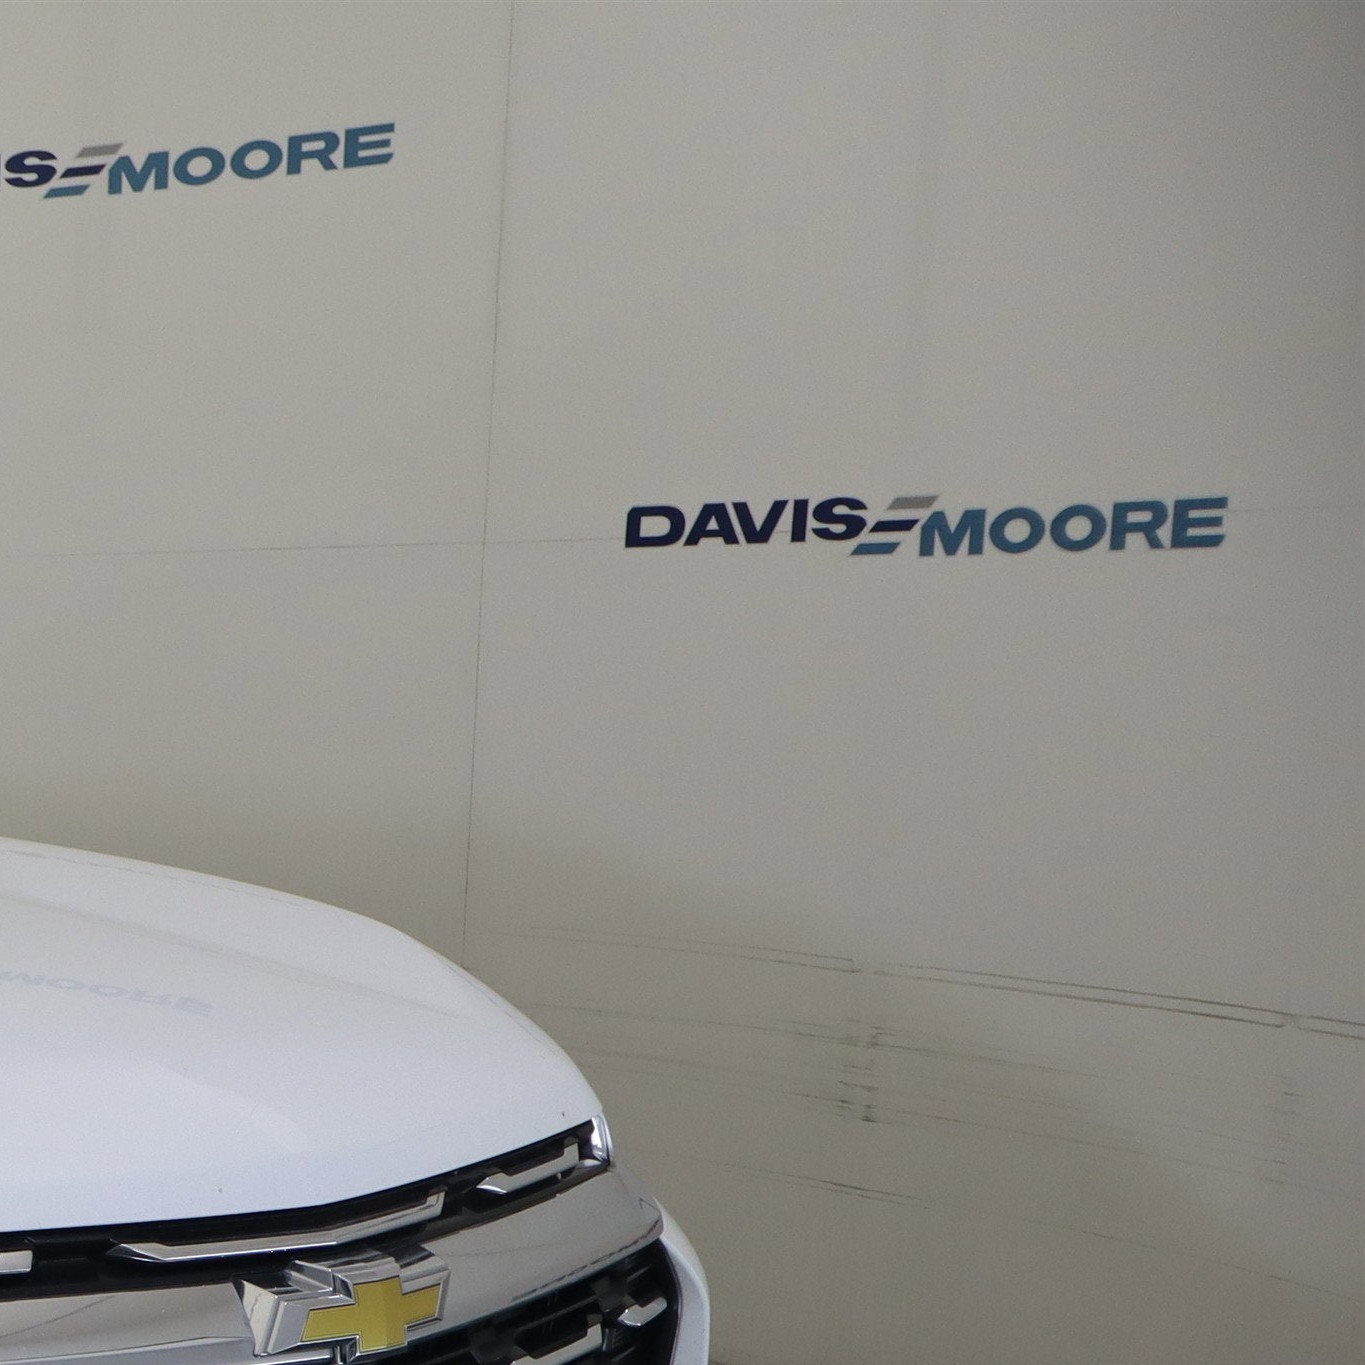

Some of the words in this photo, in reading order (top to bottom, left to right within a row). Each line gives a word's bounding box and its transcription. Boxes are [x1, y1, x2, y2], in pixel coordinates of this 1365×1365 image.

[107, 122, 396, 196] MOORE
[623, 496, 869, 549] DAVIS
[918, 496, 1229, 558] MOORE
